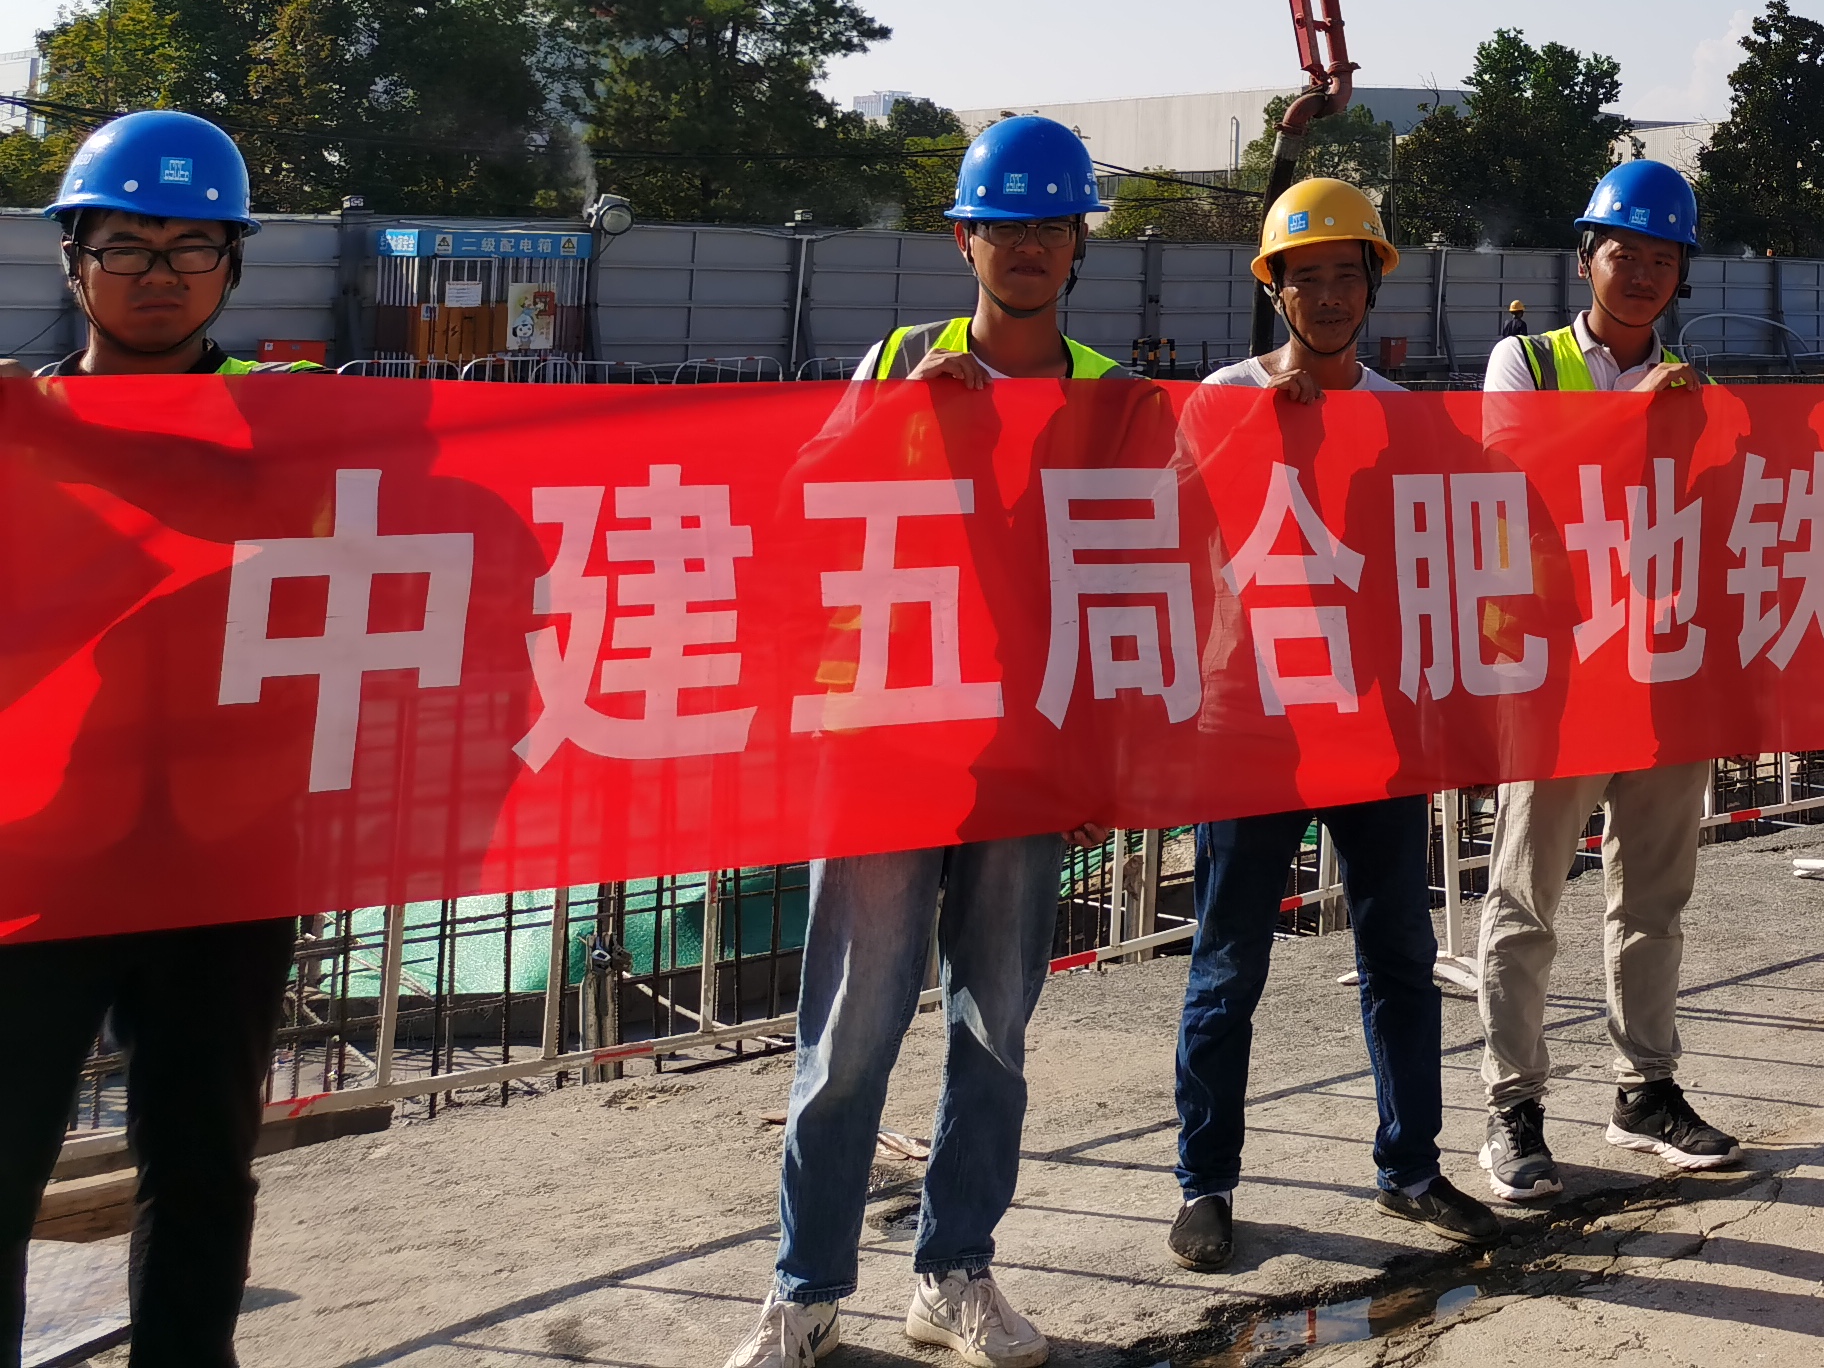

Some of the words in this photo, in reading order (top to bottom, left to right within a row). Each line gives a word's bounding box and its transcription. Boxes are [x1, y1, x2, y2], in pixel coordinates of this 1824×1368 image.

[462, 238, 552, 253] 二级配电箱
